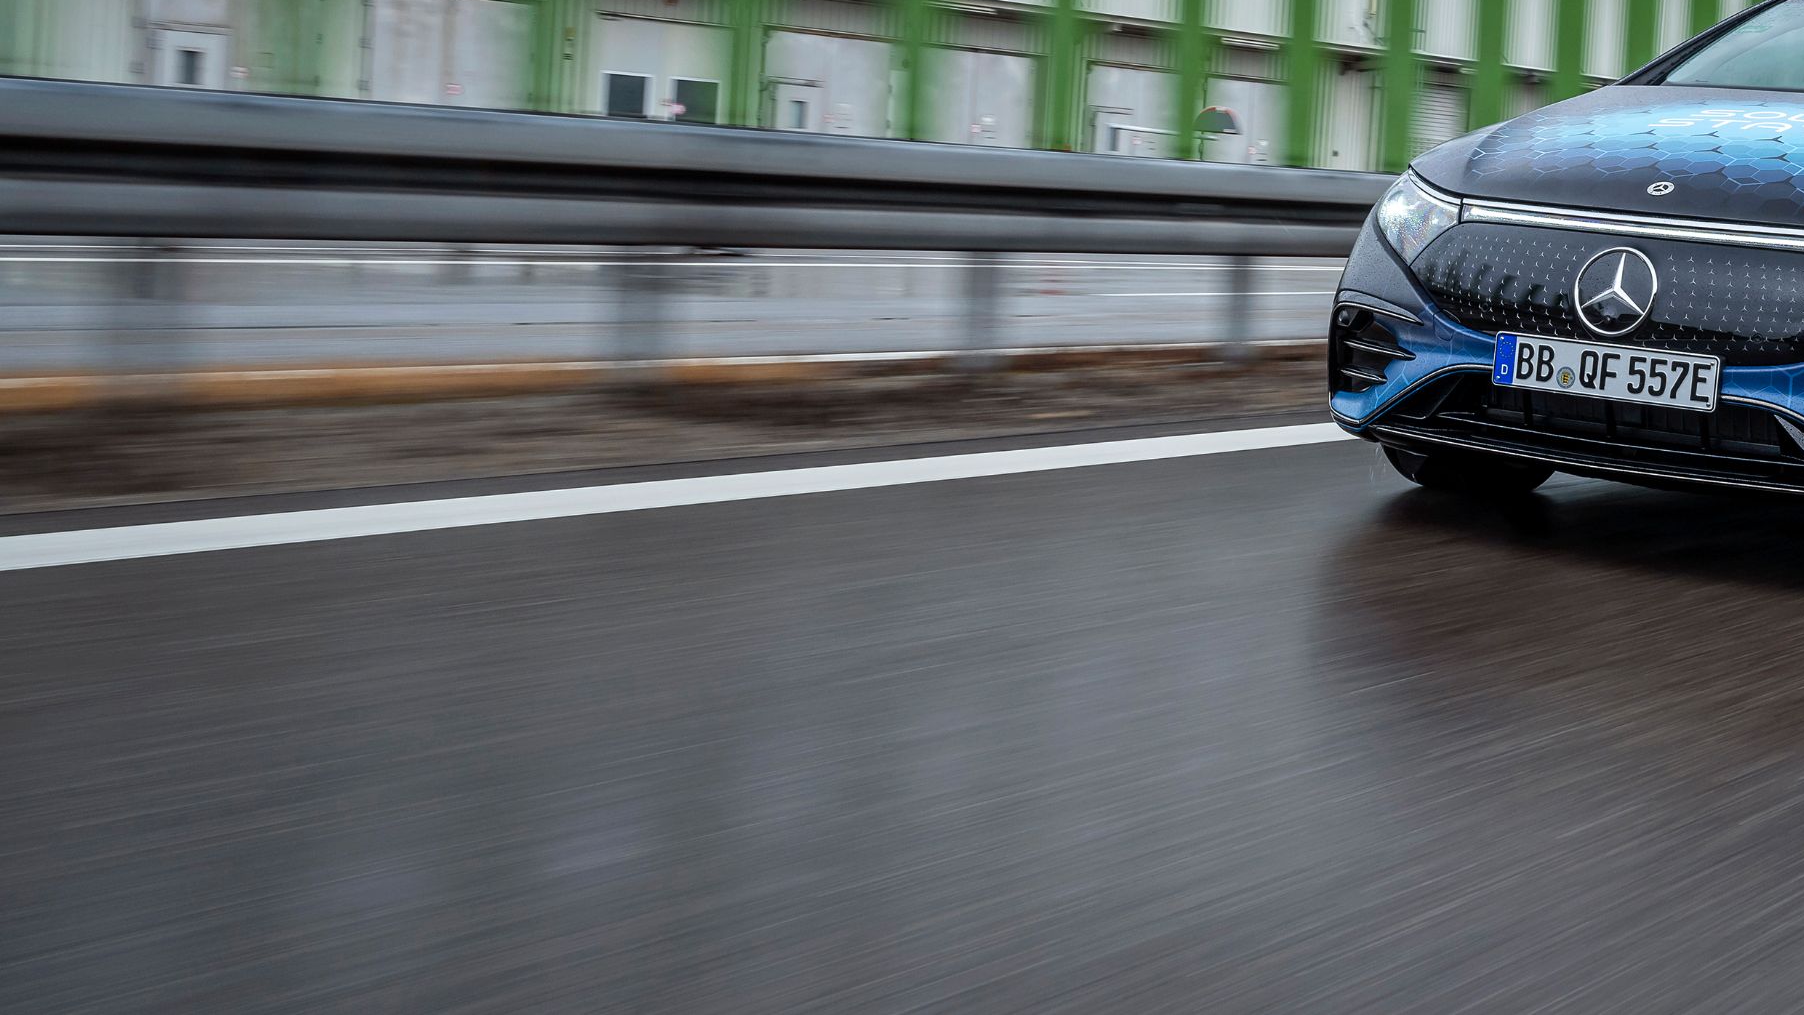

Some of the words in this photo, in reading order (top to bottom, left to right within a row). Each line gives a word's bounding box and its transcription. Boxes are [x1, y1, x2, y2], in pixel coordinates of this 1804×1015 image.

[1501, 364, 1508, 375] D
[1516, 342, 1555, 382] BB
[1579, 350, 1620, 390] QF
[1627, 356, 1713, 403] 557E
